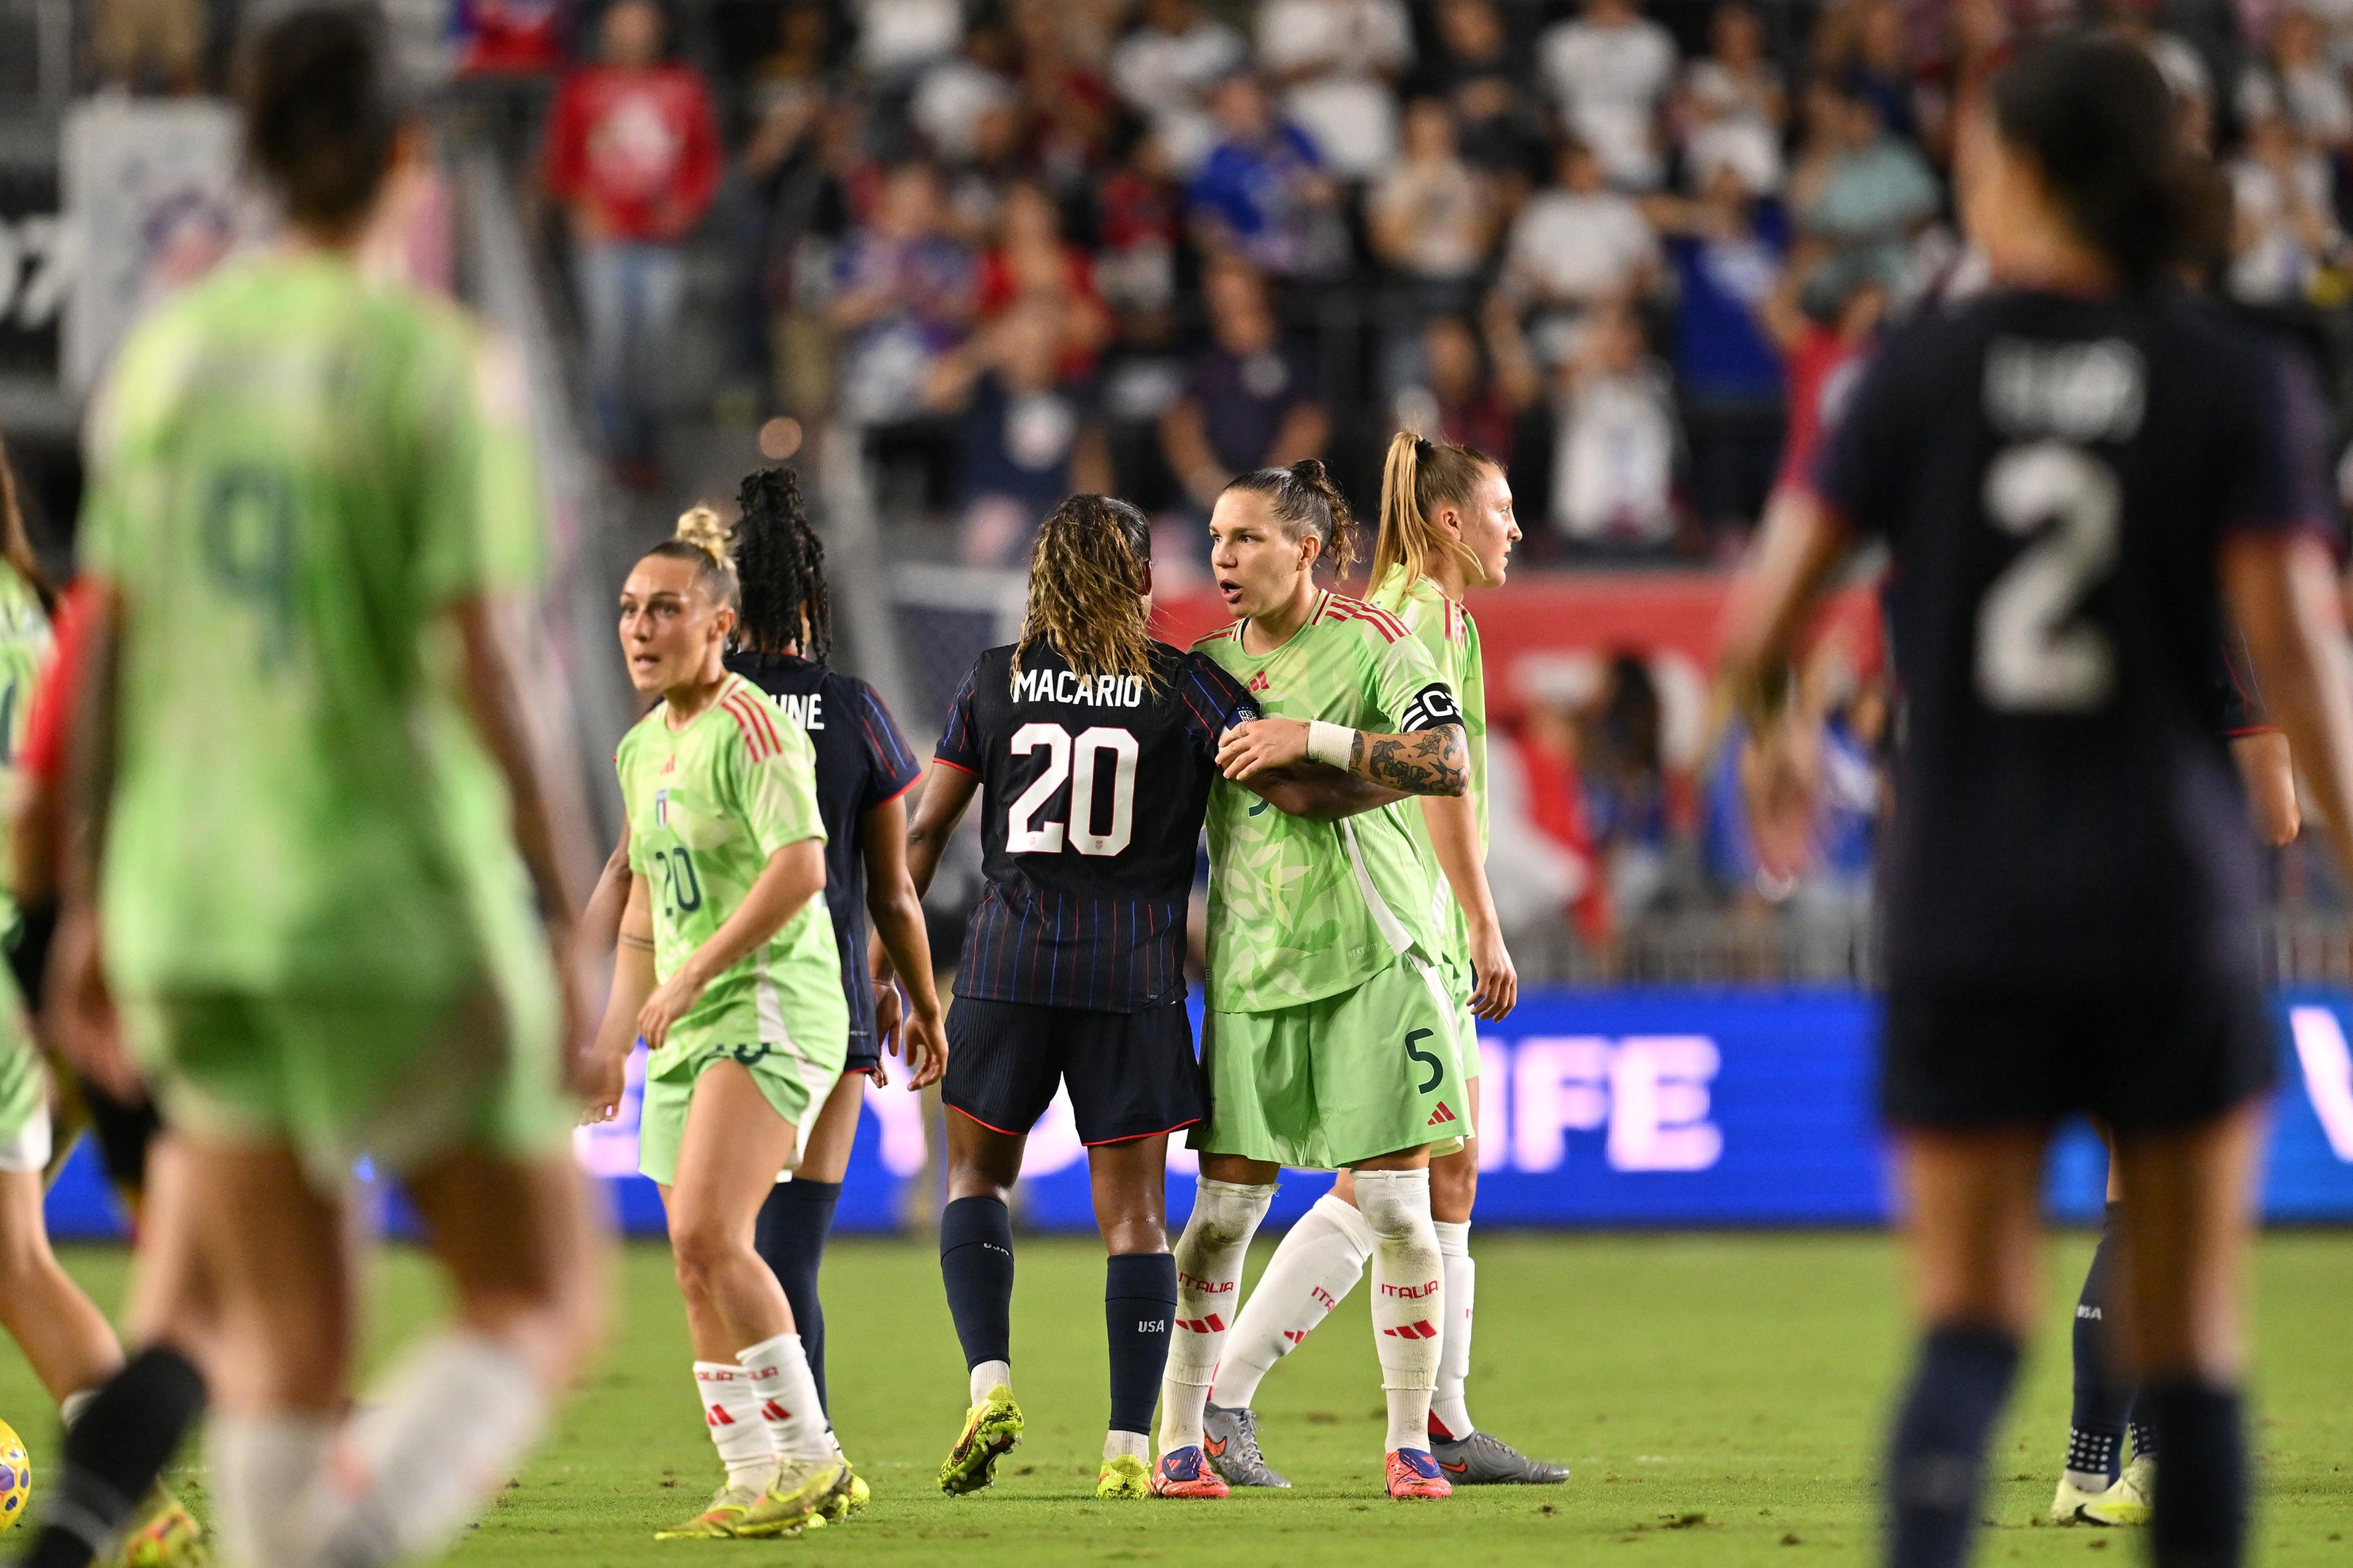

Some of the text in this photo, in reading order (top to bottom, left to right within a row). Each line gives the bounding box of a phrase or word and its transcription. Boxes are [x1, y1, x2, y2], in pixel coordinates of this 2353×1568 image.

[1976, 441, 2122, 714] 2
[1012, 668, 1143, 708] MACARIO
[1006, 723, 1139, 856] 20
[655, 847, 702, 917] 20
[1404, 1028, 1444, 1095] 5
[1477, 1034, 1724, 1173] IFE
[1178, 1272, 1234, 1293] ITALIA
[1381, 1280, 1439, 1299] ITALIA
[1138, 1319, 1164, 1333] USA
